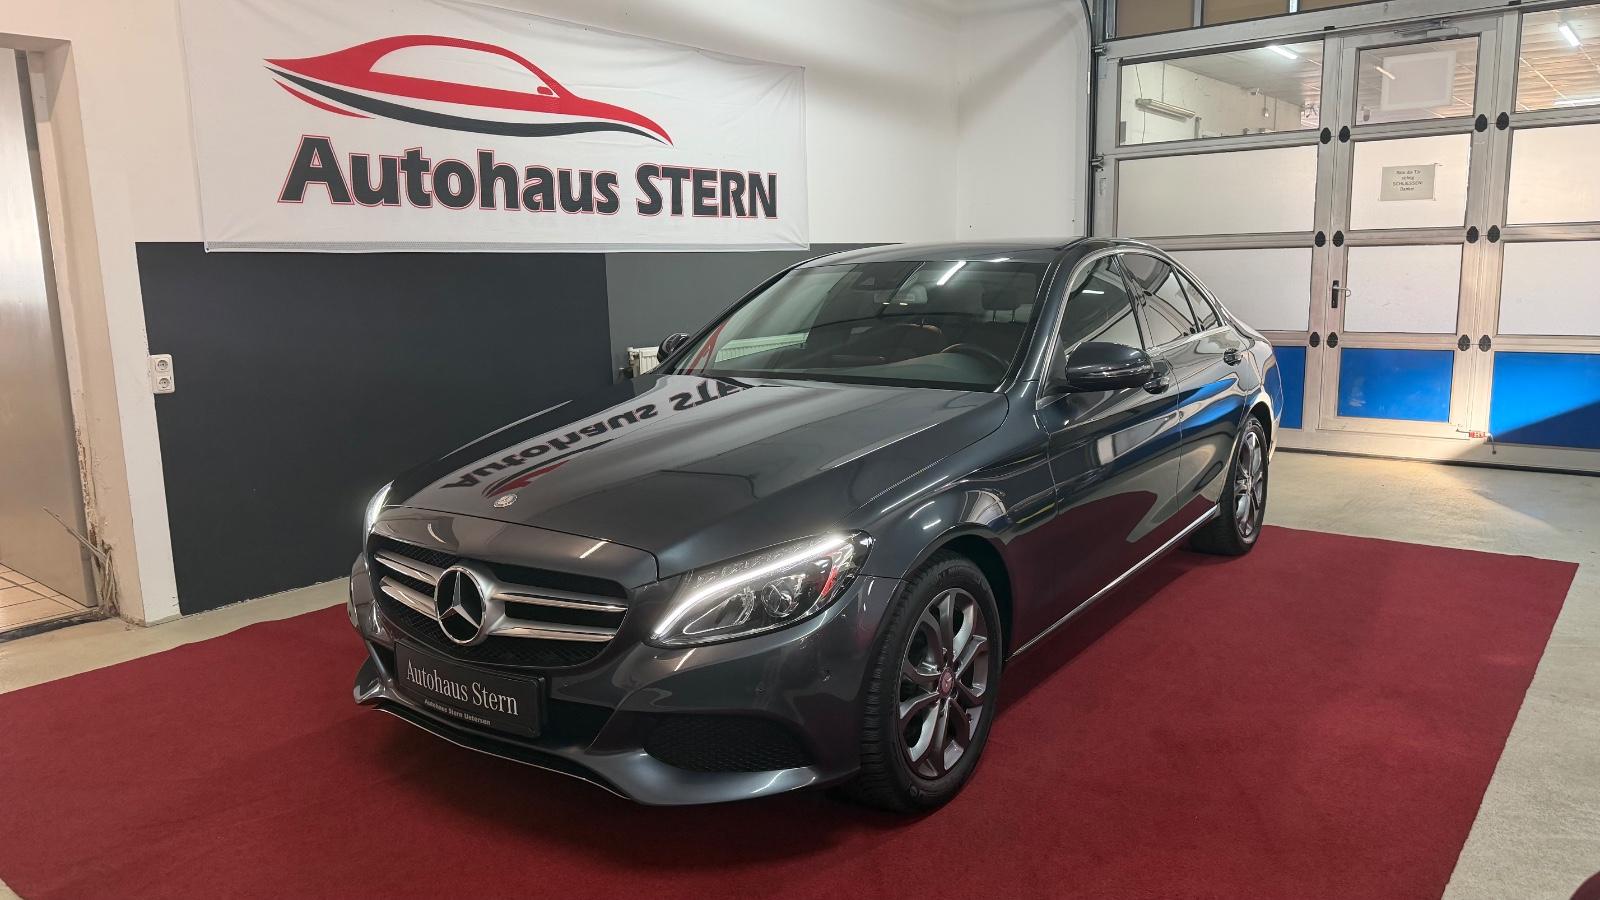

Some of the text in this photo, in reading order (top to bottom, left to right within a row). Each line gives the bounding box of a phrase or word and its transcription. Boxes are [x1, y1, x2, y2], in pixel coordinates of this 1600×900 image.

[277, 135, 778, 219] Autohaus STERN
[406, 658, 519, 716] Autohaus Stern
[424, 699, 448, 713] Autohaus
[448, 707, 463, 718] Stern
